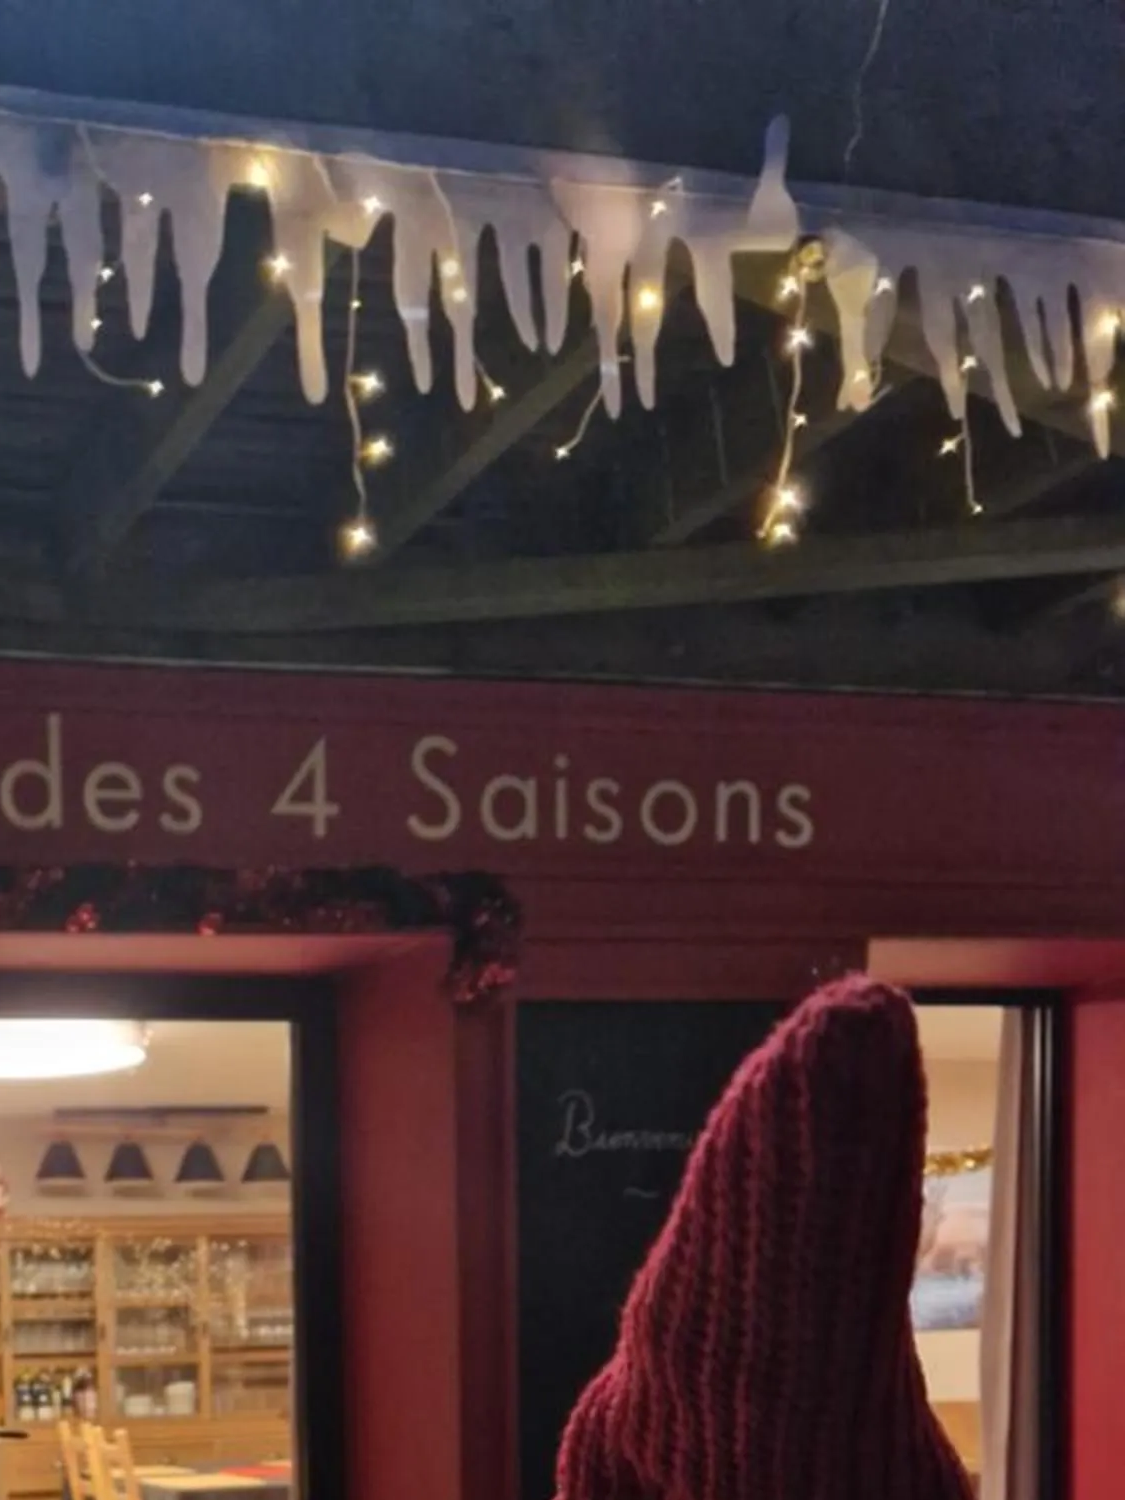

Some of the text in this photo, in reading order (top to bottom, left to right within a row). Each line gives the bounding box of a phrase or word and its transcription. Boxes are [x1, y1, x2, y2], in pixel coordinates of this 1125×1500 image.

[0, 714, 203, 833] des
[272, 737, 339, 837] 4
[406, 736, 815, 848] Saisons
